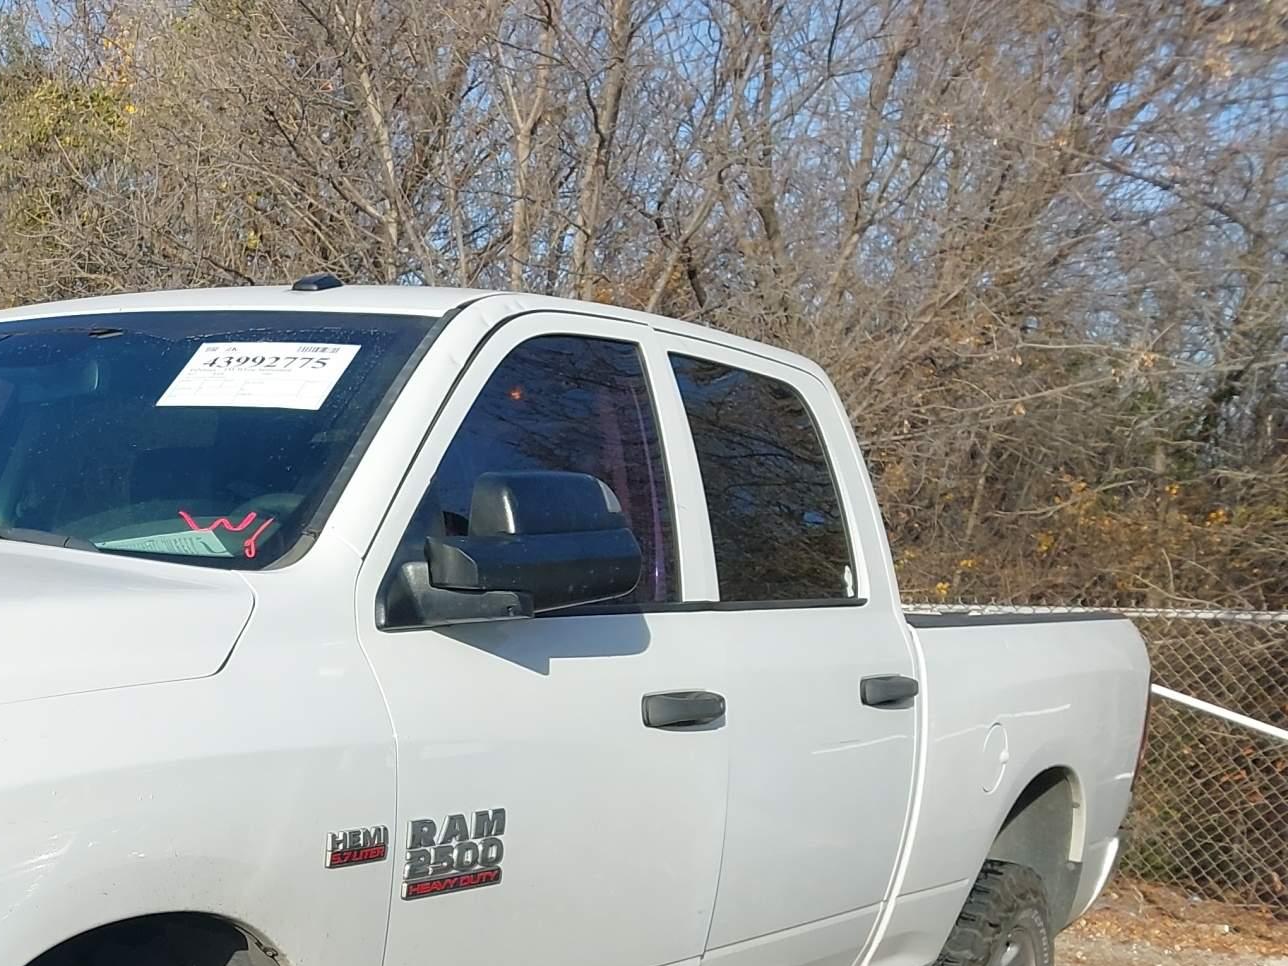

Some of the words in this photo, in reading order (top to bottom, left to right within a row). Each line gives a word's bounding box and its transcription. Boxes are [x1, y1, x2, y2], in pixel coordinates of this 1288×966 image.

[202, 355, 331, 369] 43992775
[327, 825, 389, 852] HEMI
[406, 807, 506, 850] RAM
[331, 850, 348, 865] 5.7
[349, 846, 385, 863] LITER
[403, 837, 504, 880] 2500
[408, 876, 456, 896] HEAVY
[459, 869, 500, 886] DUTY
